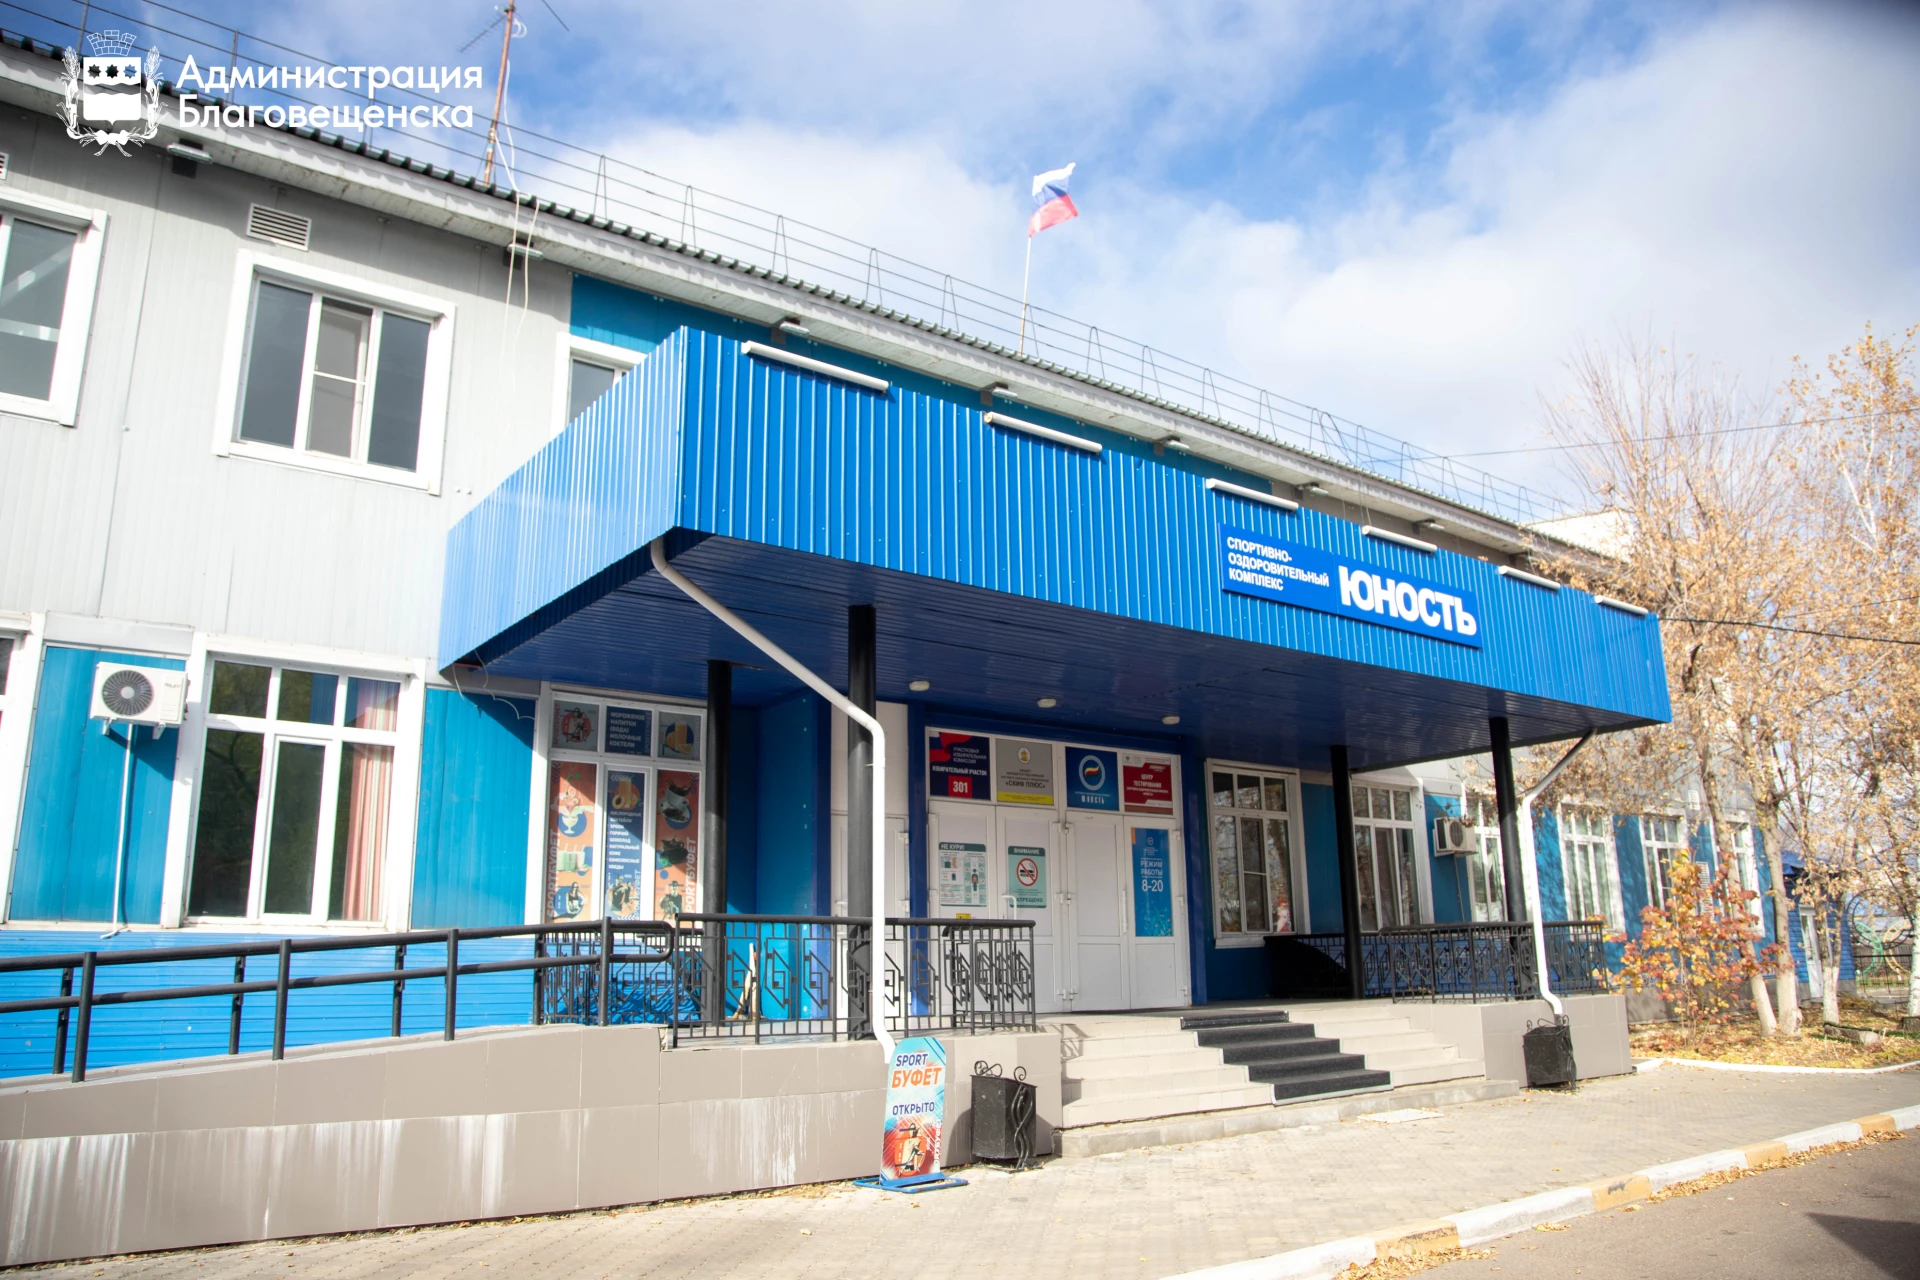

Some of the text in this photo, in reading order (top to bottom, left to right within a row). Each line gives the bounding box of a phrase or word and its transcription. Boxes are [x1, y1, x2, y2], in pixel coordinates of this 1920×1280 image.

[1227, 536, 1293, 563] СПОРТИВНО-
[1228, 552, 1330, 587] ОЗДОРОВИТЕЛЬНЫЙ
[1229, 567, 1284, 591] КОМПЛЕКС
[1338, 565, 1478, 636] ЮНОСТЬ
[610, 711, 645, 721] МОРОЖЕНОЕ
[610, 719, 637, 727] НАПИТКИ
[609, 726, 630, 734] (ВОДА)
[609, 733, 642, 742] МОЛОЧНЫЕ
[609, 740, 635, 748] КОКТЕЛИ
[953, 752, 988, 760] ИЗБИРАТЕЛЬНАЯ
[932, 765, 968, 774] ИЗБИРАТЕЛЬНЫЙ
[953, 780, 968, 793] 301
[1140, 860, 1163, 868] РЕЖИМ
[686, 837, 697, 914] PORTБУФЕТ
[1140, 868, 1163, 876] РАБОТЫ
[1142, 879, 1164, 892] 8-20
[1016, 896, 1043, 904] АПРЕЩЕНО
[896, 1054, 928, 1067] SPORT
[891, 1068, 942, 1088] БУФЕТ
[892, 1102, 935, 1115] ОТКРЫТО
